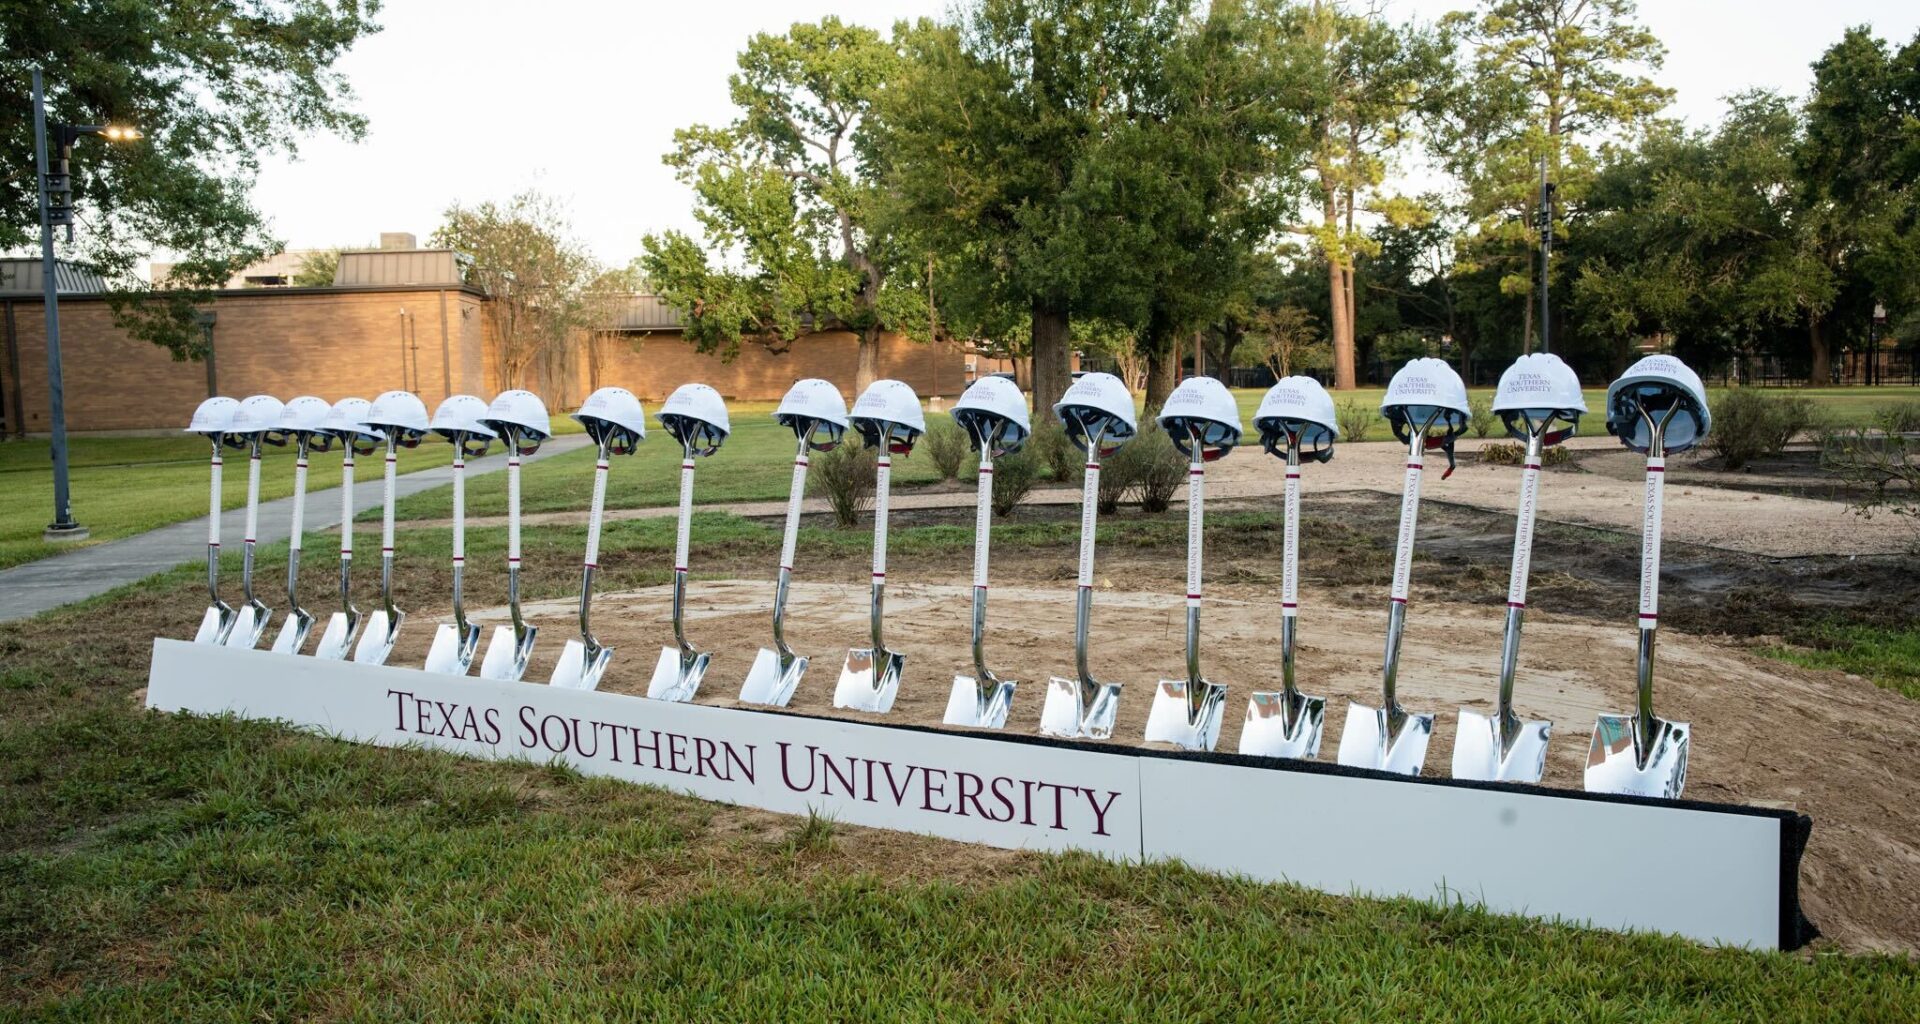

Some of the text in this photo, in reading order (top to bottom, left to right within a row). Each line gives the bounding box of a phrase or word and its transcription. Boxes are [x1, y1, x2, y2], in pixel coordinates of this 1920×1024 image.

[1270, 393, 1306, 401] SOUTHERN
[1394, 388, 1437, 396] UNIVERSITY
[1506, 385, 1552, 394] UNIVERSITY
[1508, 379, 1551, 387] SOUTHERN
[975, 540, 984, 583] UNIVERSITY
[977, 498, 986, 540] SOUTHERN
[1080, 472, 1095, 583] TEXAS SOUTHERN UNIVERSITY
[1189, 478, 1199, 592] TEXAS SOUTHERN UNIVERSITY
[1284, 481, 1296, 601] TEXAS SOUTHERN UNIVERSITY
[1395, 472, 1417, 596] TEXAS SOUTHERN UNIVERSITY
[1512, 473, 1535, 599] TEXAS SOUTHERN UNIVERSITY
[1642, 475, 1657, 611] TEXAS SOUTHERN UNIVERSITY
[387, 689, 1122, 836] TEXAS SOUTHERN UNIVERSITY
